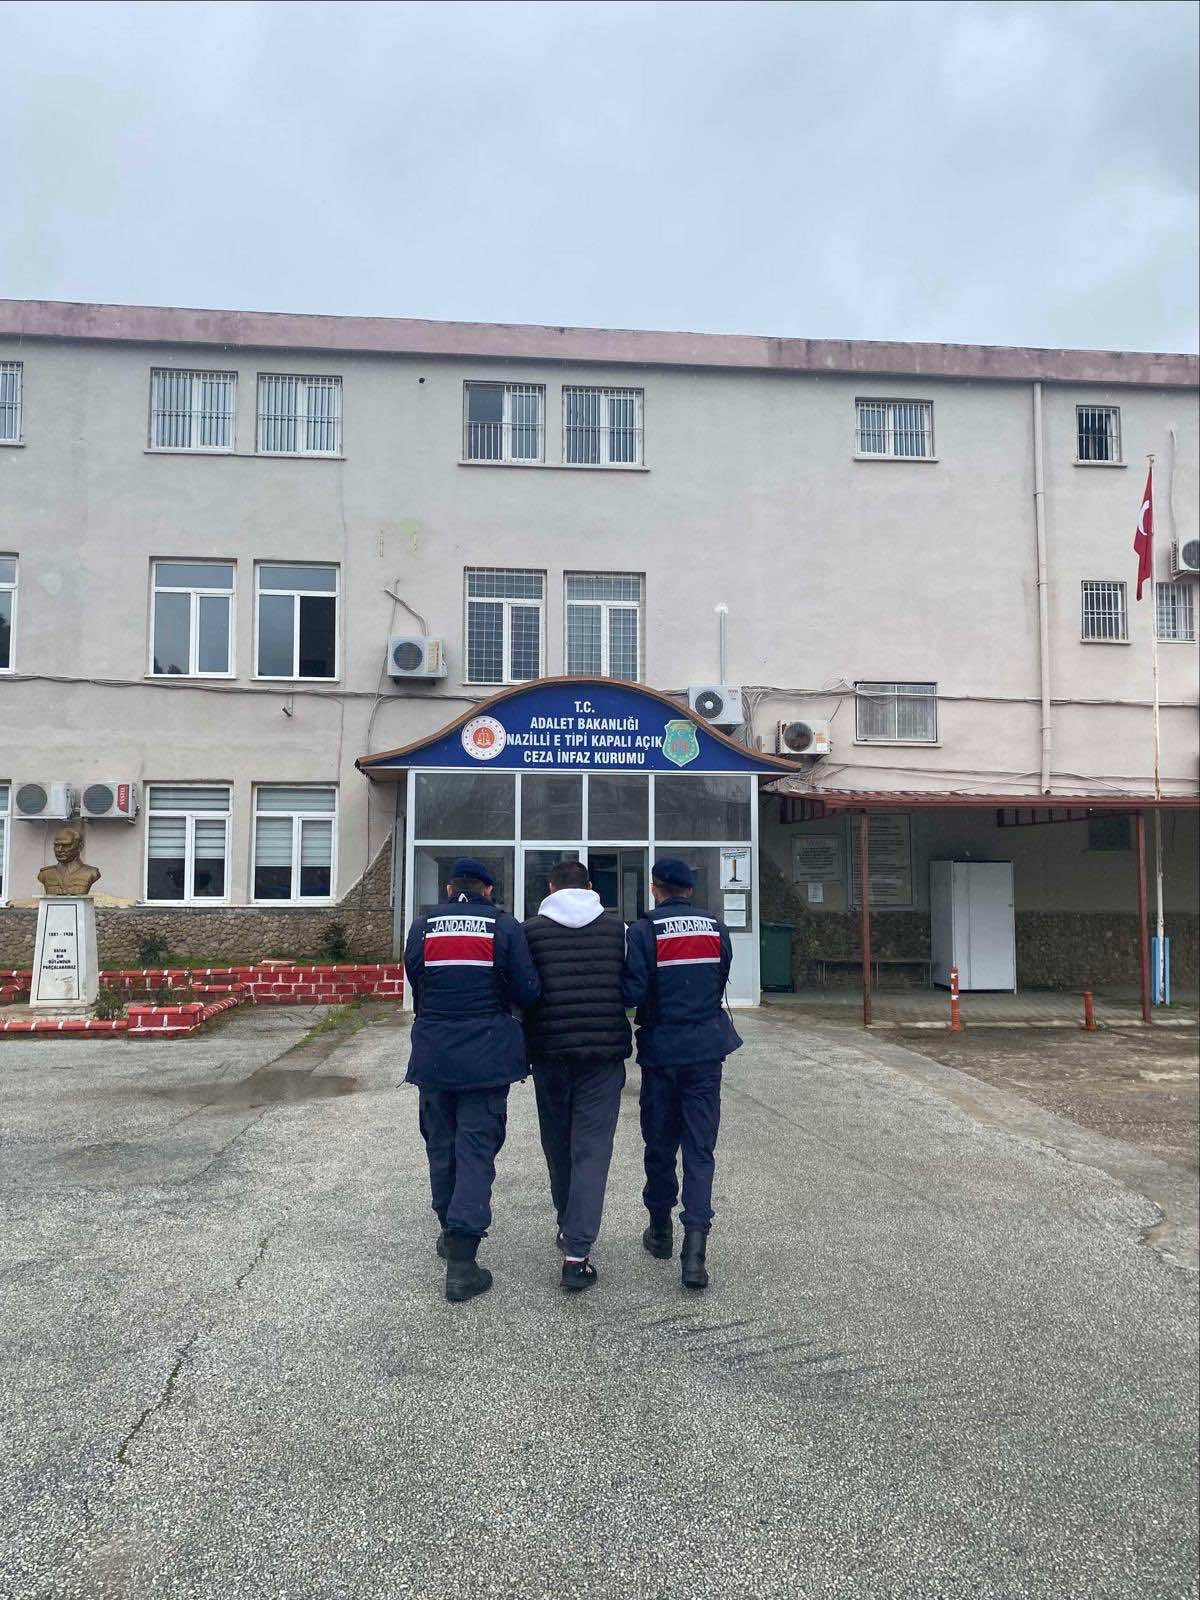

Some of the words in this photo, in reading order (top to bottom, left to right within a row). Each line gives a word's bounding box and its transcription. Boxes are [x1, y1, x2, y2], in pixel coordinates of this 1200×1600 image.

[574, 701, 595, 713] T.C.
[530, 717, 574, 730] ADALET
[577, 716, 639, 731] BAKANLIĞI
[506, 731, 550, 747] NAZİLLİ
[554, 734, 561, 747] E
[564, 731, 588, 747] TİPİ
[591, 734, 632, 748] KAPALI
[634, 734, 663, 751] AÇIK
[523, 750, 554, 764] CEZA
[557, 749, 590, 764] İNFAZ
[594, 751, 645, 765] KURUMU
[432, 919, 487, 933] JANDARMA
[663, 919, 714, 934] JANDARMA
